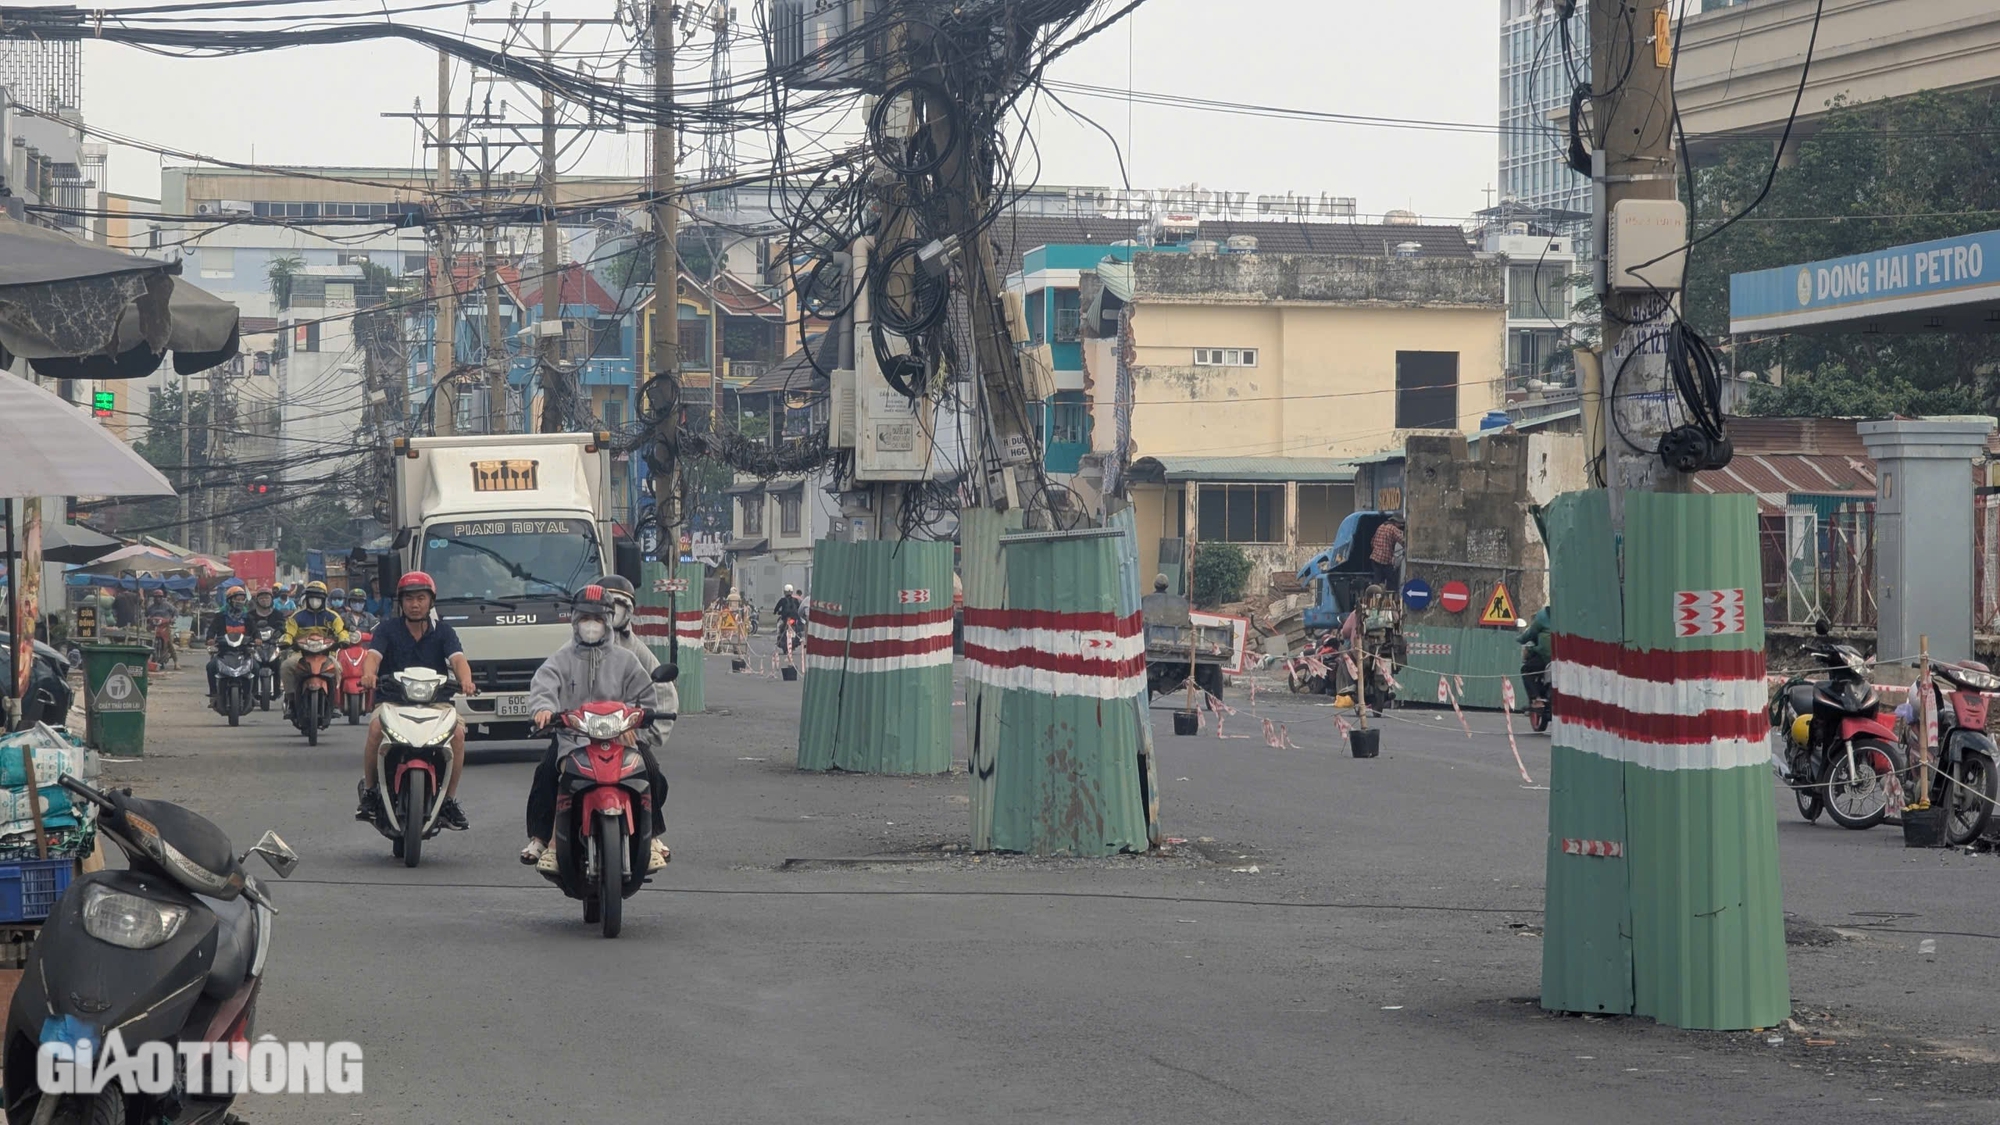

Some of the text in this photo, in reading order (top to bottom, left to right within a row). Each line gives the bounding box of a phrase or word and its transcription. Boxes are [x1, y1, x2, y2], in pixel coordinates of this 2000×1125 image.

[1817, 243, 1983, 300] DONG HAI PETRO
[454, 521, 570, 537] PIANO ROYAL
[495, 614, 537, 625] SUZU
[508, 696, 526, 705] 60C
[501, 705, 530, 715] 619.0
